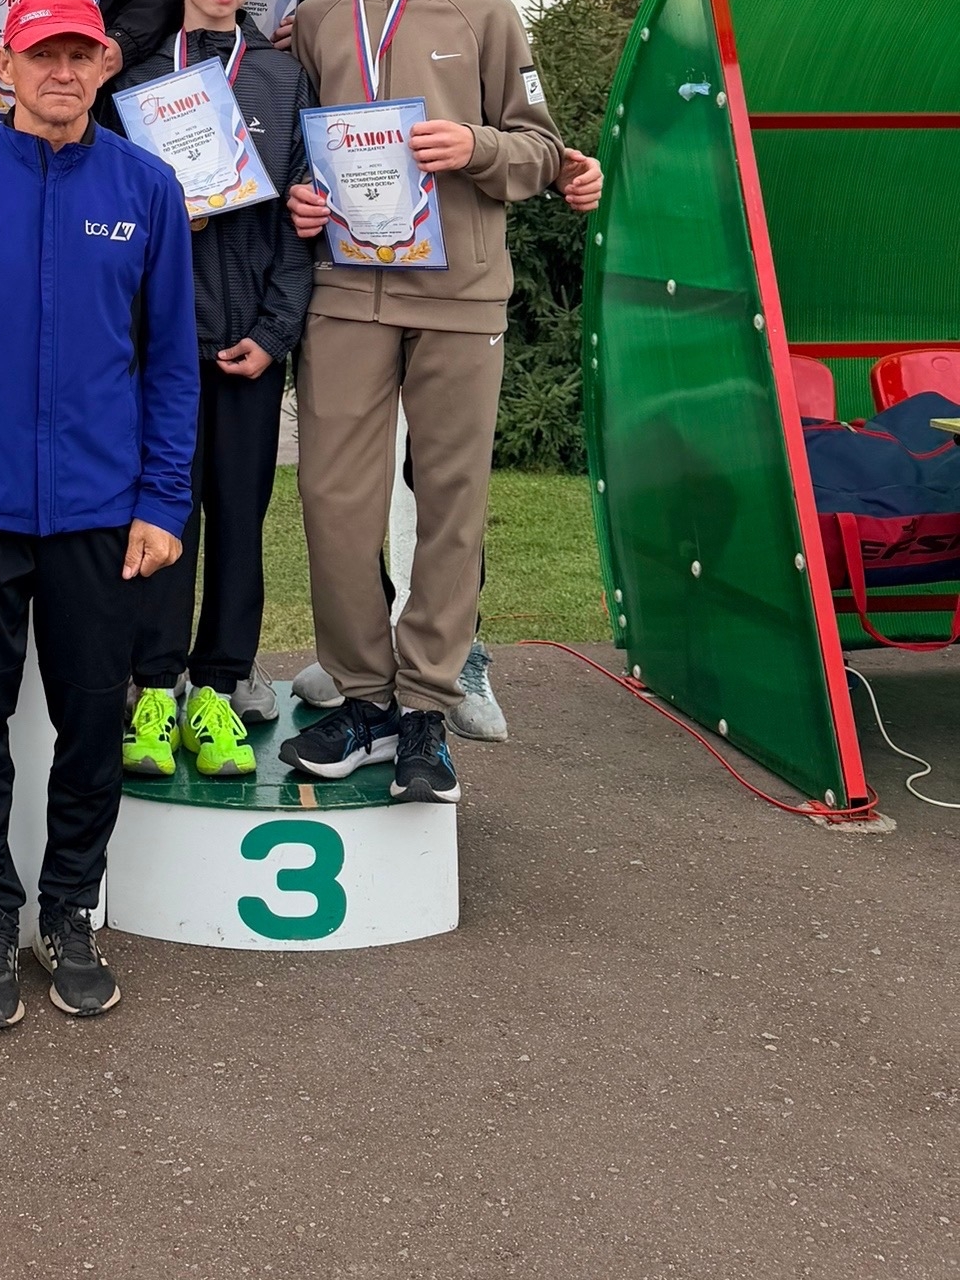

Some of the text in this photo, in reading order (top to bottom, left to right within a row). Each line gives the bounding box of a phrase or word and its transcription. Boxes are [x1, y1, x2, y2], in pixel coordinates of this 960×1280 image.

[140, 90, 210, 126] ГРАМОТА
[194, 126, 214, 137] ГОРОДА
[326, 118, 404, 151] ГРАМОТА
[345, 170, 377, 178] ПЕРВЕНСТВЕ
[85, 220, 109, 236] tcs
[238, 820, 346, 940] 3
